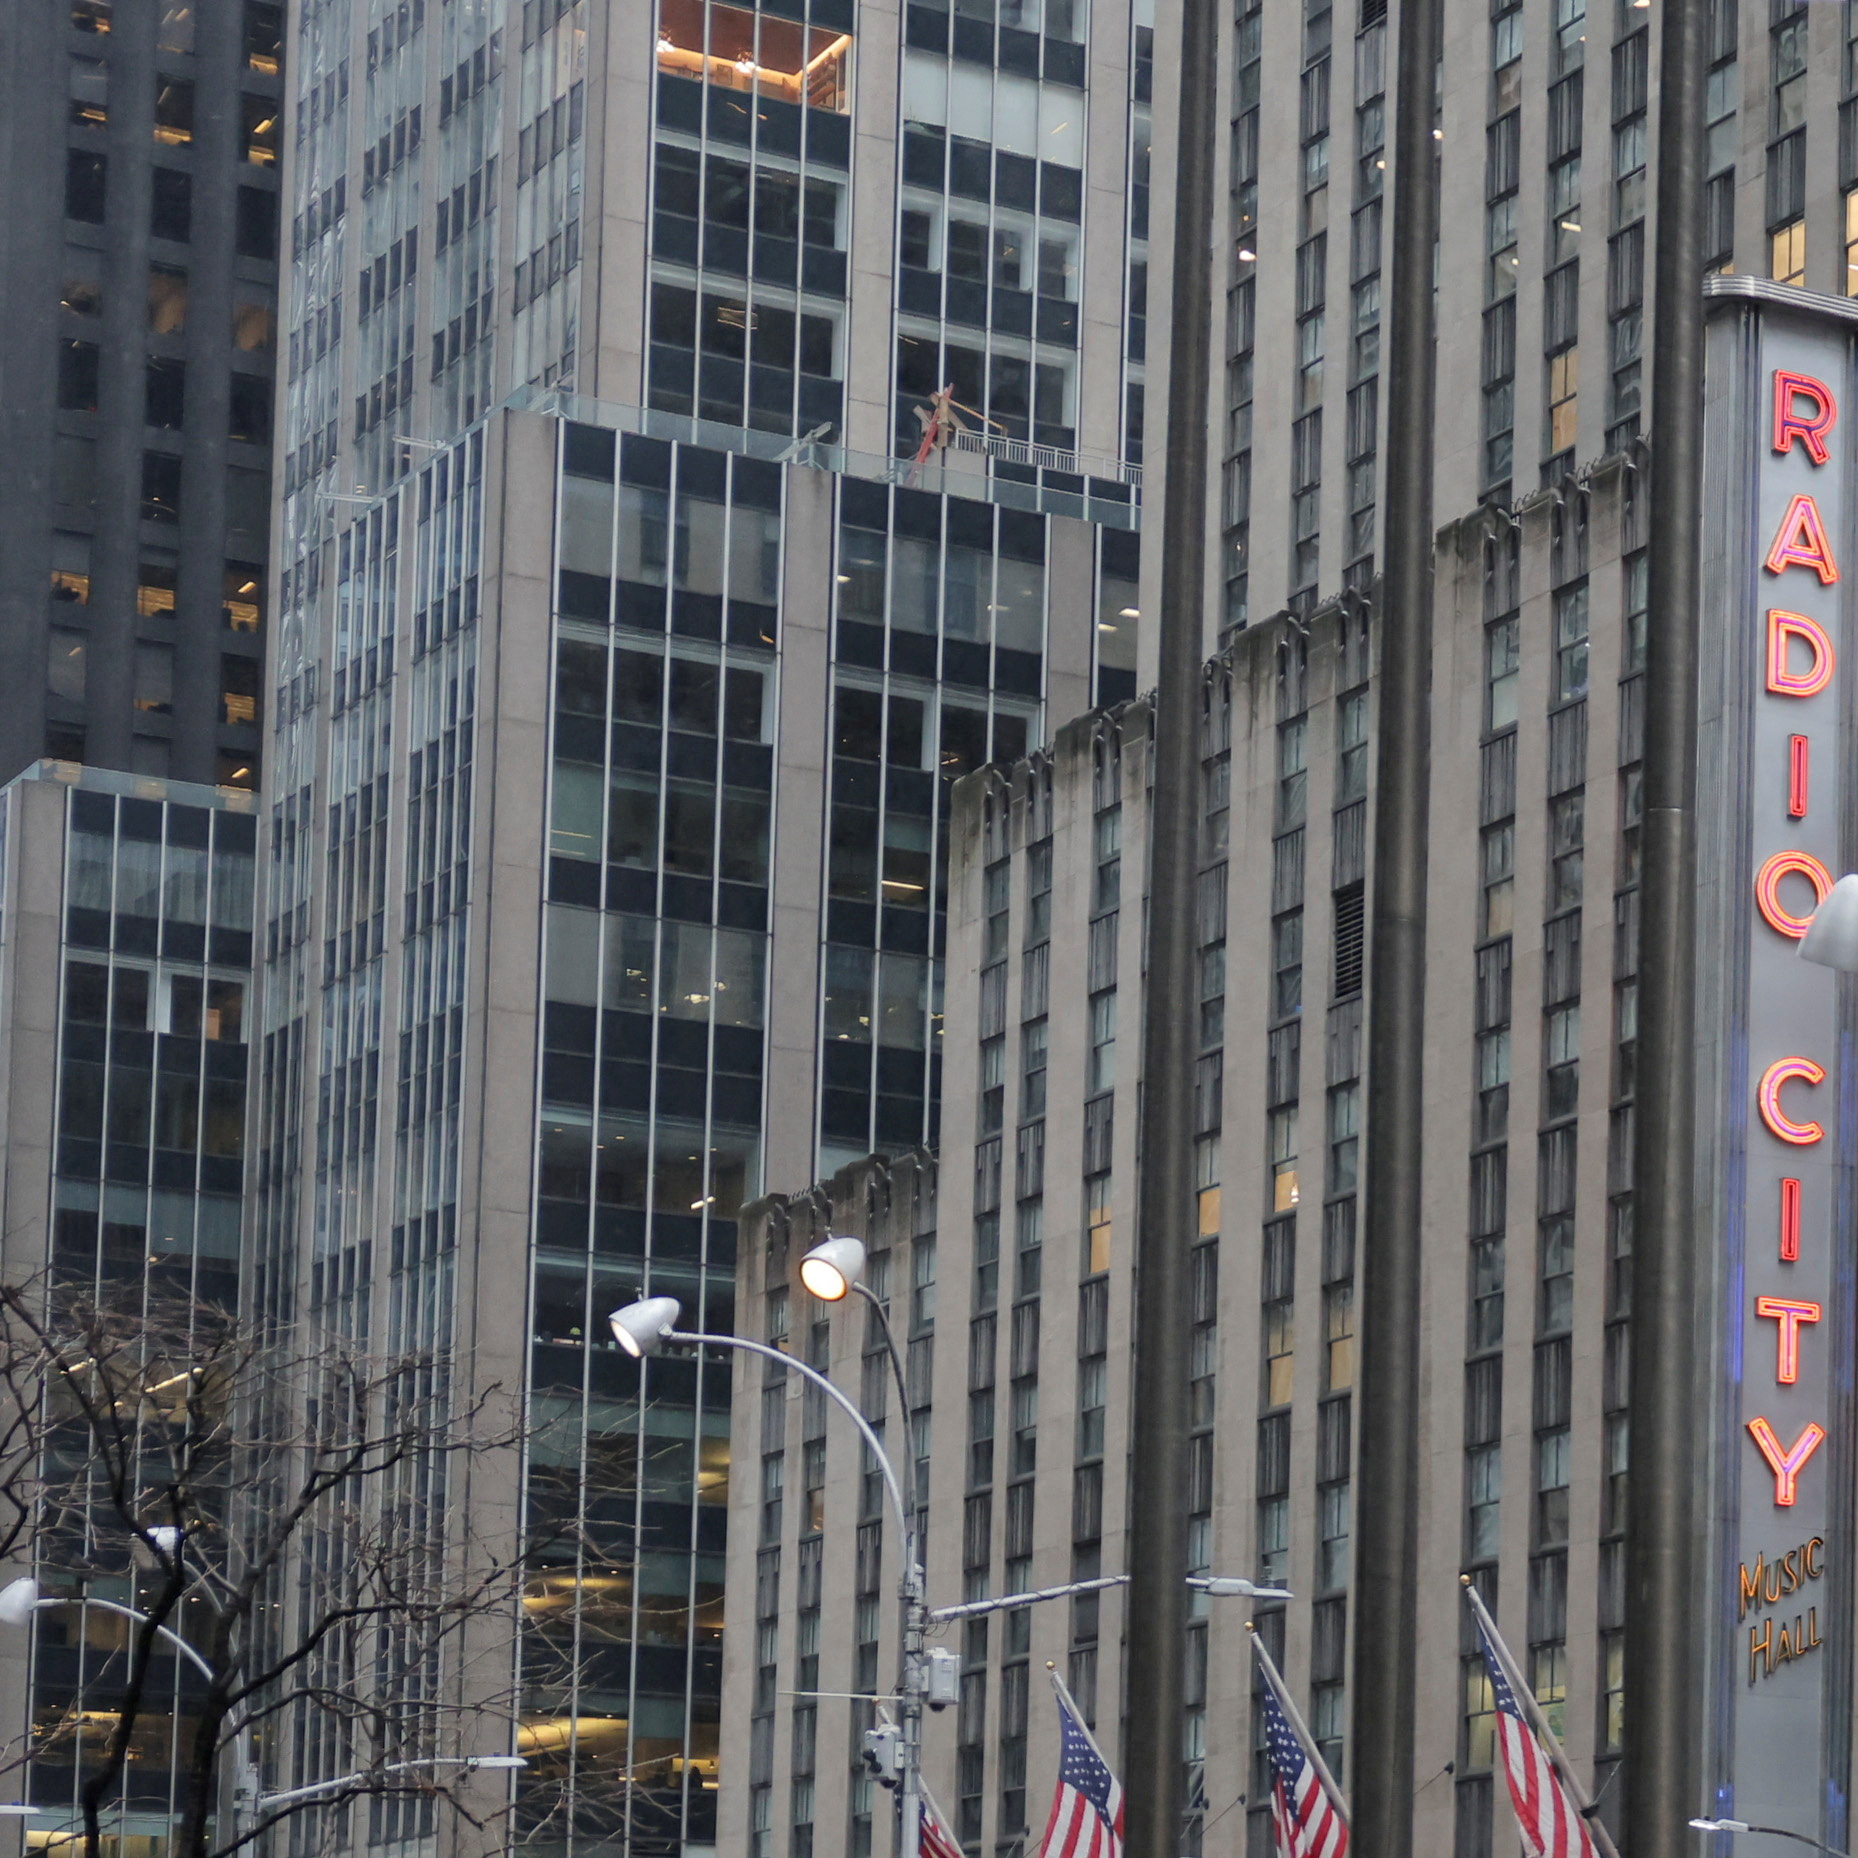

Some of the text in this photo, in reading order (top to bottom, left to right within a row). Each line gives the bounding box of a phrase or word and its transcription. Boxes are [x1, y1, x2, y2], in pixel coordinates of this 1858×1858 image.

[1746, 367, 1840, 1507] RADIO CITY
[1738, 1536, 1824, 1624] MUSIC
[1748, 1607, 1822, 1684] HALL
